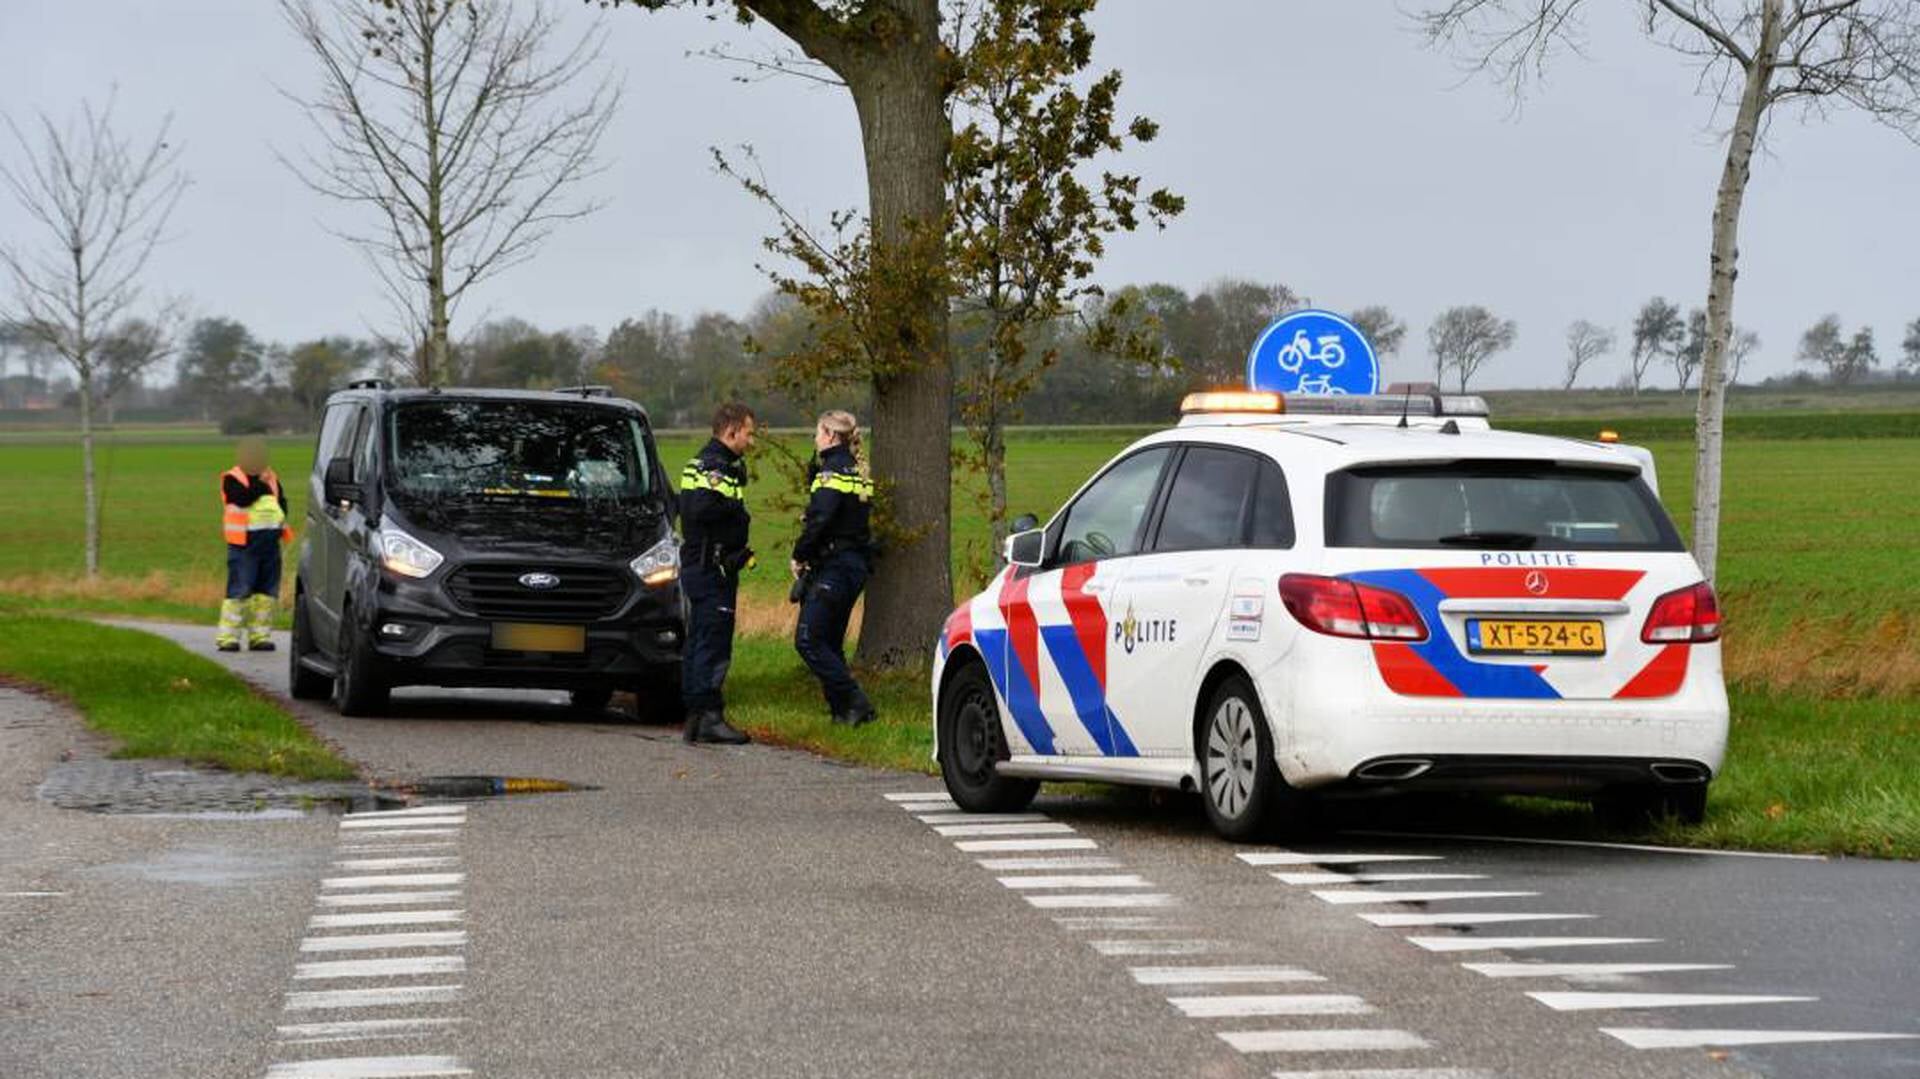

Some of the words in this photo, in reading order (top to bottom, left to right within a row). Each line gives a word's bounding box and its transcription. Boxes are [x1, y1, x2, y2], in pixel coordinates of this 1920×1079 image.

[1481, 552, 1578, 566] POLITIE
[1115, 619, 1176, 654] POLITIE
[1488, 625, 1595, 646] XT-524-G
